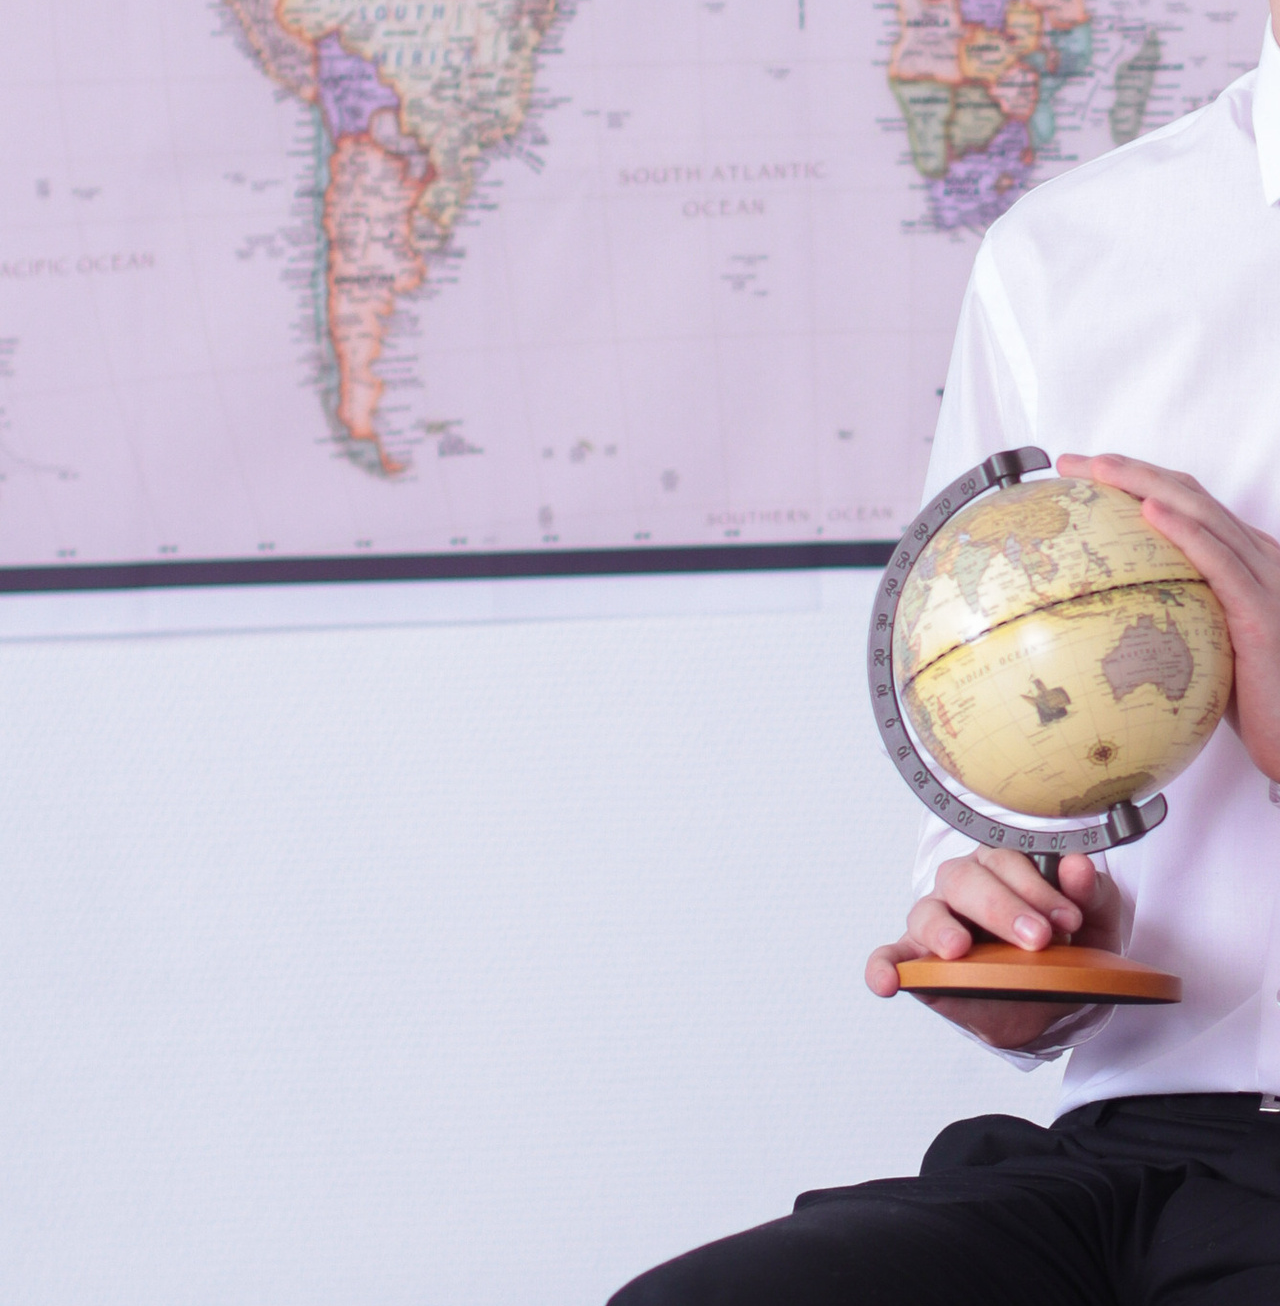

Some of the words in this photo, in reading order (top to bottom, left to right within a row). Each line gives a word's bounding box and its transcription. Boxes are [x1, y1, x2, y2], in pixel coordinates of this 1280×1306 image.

[619, 165, 701, 187] SOUTH
[710, 161, 827, 182] ATLANTIC
[681, 198, 766, 219] OCEAN
[75, 251, 156, 275] OCEAN
[934, 497, 951, 517] 70
[912, 522, 930, 541] 60
[895, 550, 911, 571] 50
[875, 613, 890, 633] 30
[873, 648, 886, 667] 20
